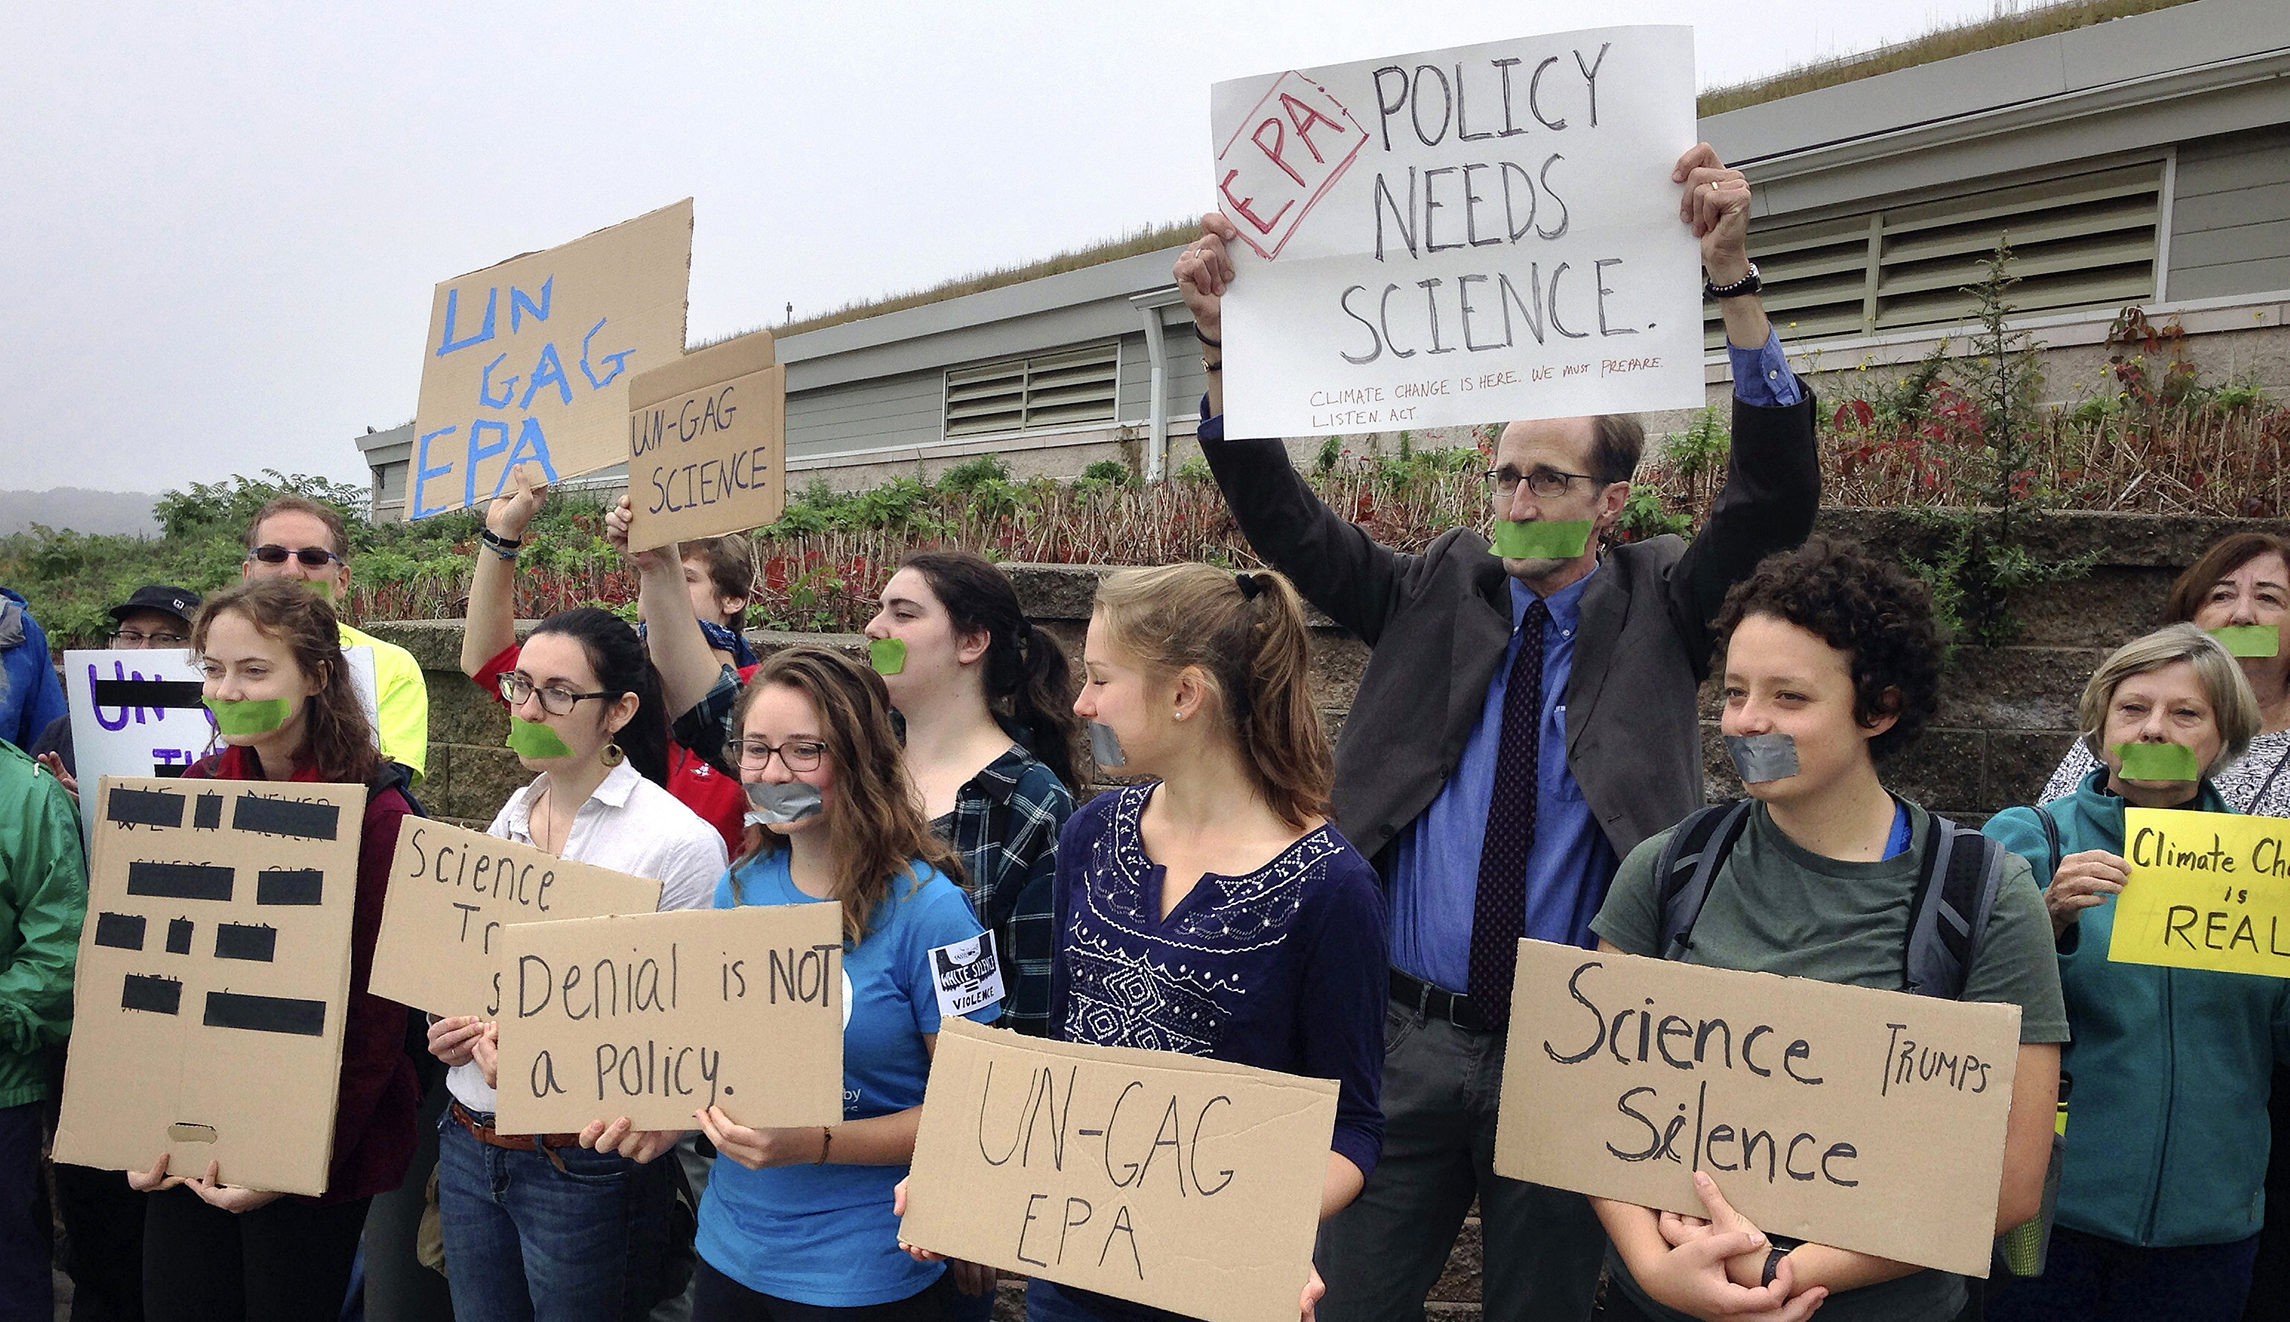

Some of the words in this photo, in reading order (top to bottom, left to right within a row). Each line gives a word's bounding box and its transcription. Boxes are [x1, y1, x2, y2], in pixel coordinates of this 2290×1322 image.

[1371, 42, 1611, 151] POLICY
[1374, 152, 1569, 262] NEEDS
[435, 273, 554, 357] UN
[1339, 257, 1658, 365] SCIENCE.
[478, 317, 636, 410] GAG
[1310, 387, 1385, 407] CLIMATE
[1394, 379, 1450, 399] CHANGE
[1460, 377, 1474, 392] IS
[1479, 370, 1522, 389] HERE.
[1531, 365, 1554, 382] WE
[1601, 357, 1663, 378] PREPARE.
[631, 386, 738, 457] UN-GAG
[1312, 410, 1382, 428] LISTEN.
[409, 416, 558, 521] EPA
[649, 446, 767, 515] SCIENCE
[410, 828, 555, 912] Science
[2132, 827, 2237, 873] Climate
[2164, 905, 2290, 957] REAL
[2224, 886, 2248, 905] is
[517, 943, 678, 1021] Denial
[722, 950, 746, 1001] is
[769, 944, 842, 1008] NOT
[941, 965, 971, 988] WHITE
[952, 986, 995, 1010] VIOLENCE
[1543, 962, 1824, 1085] Science
[531, 1050, 567, 1098] a
[978, 1061, 1234, 1197] UN-GAG
[1605, 1081, 1859, 1187] Silence
[1017, 1194, 1144, 1280] EPA
